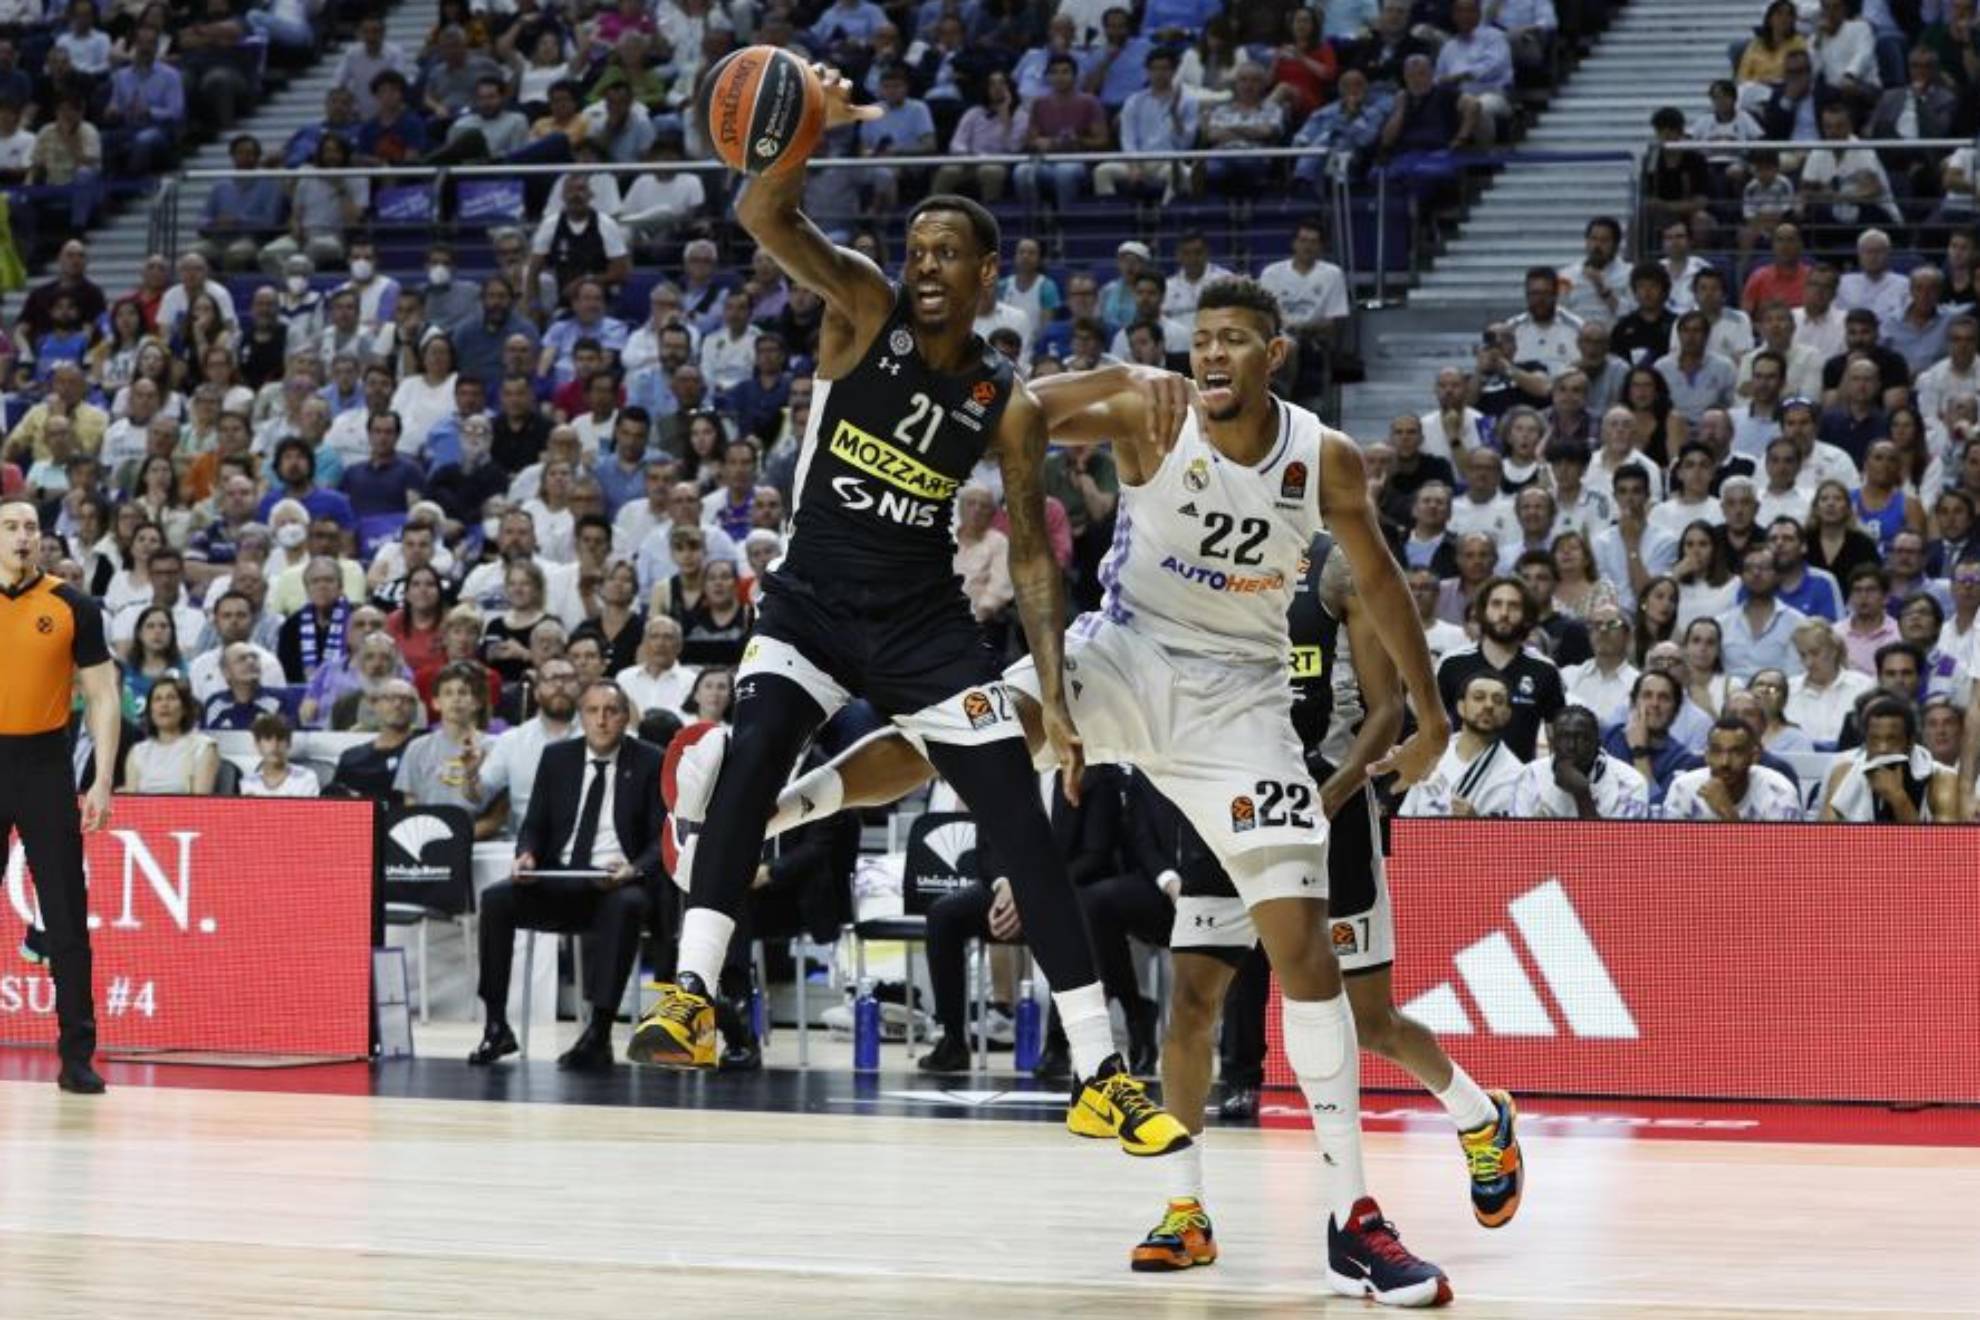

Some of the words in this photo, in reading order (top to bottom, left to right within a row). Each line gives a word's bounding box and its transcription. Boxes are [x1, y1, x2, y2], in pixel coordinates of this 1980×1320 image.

[893, 393, 944, 454] 21
[1200, 512, 1270, 565] 22
[1161, 555, 1284, 593] AUTOHERO
[1255, 780, 1315, 829] 22
[106, 976, 156, 1017] #4
